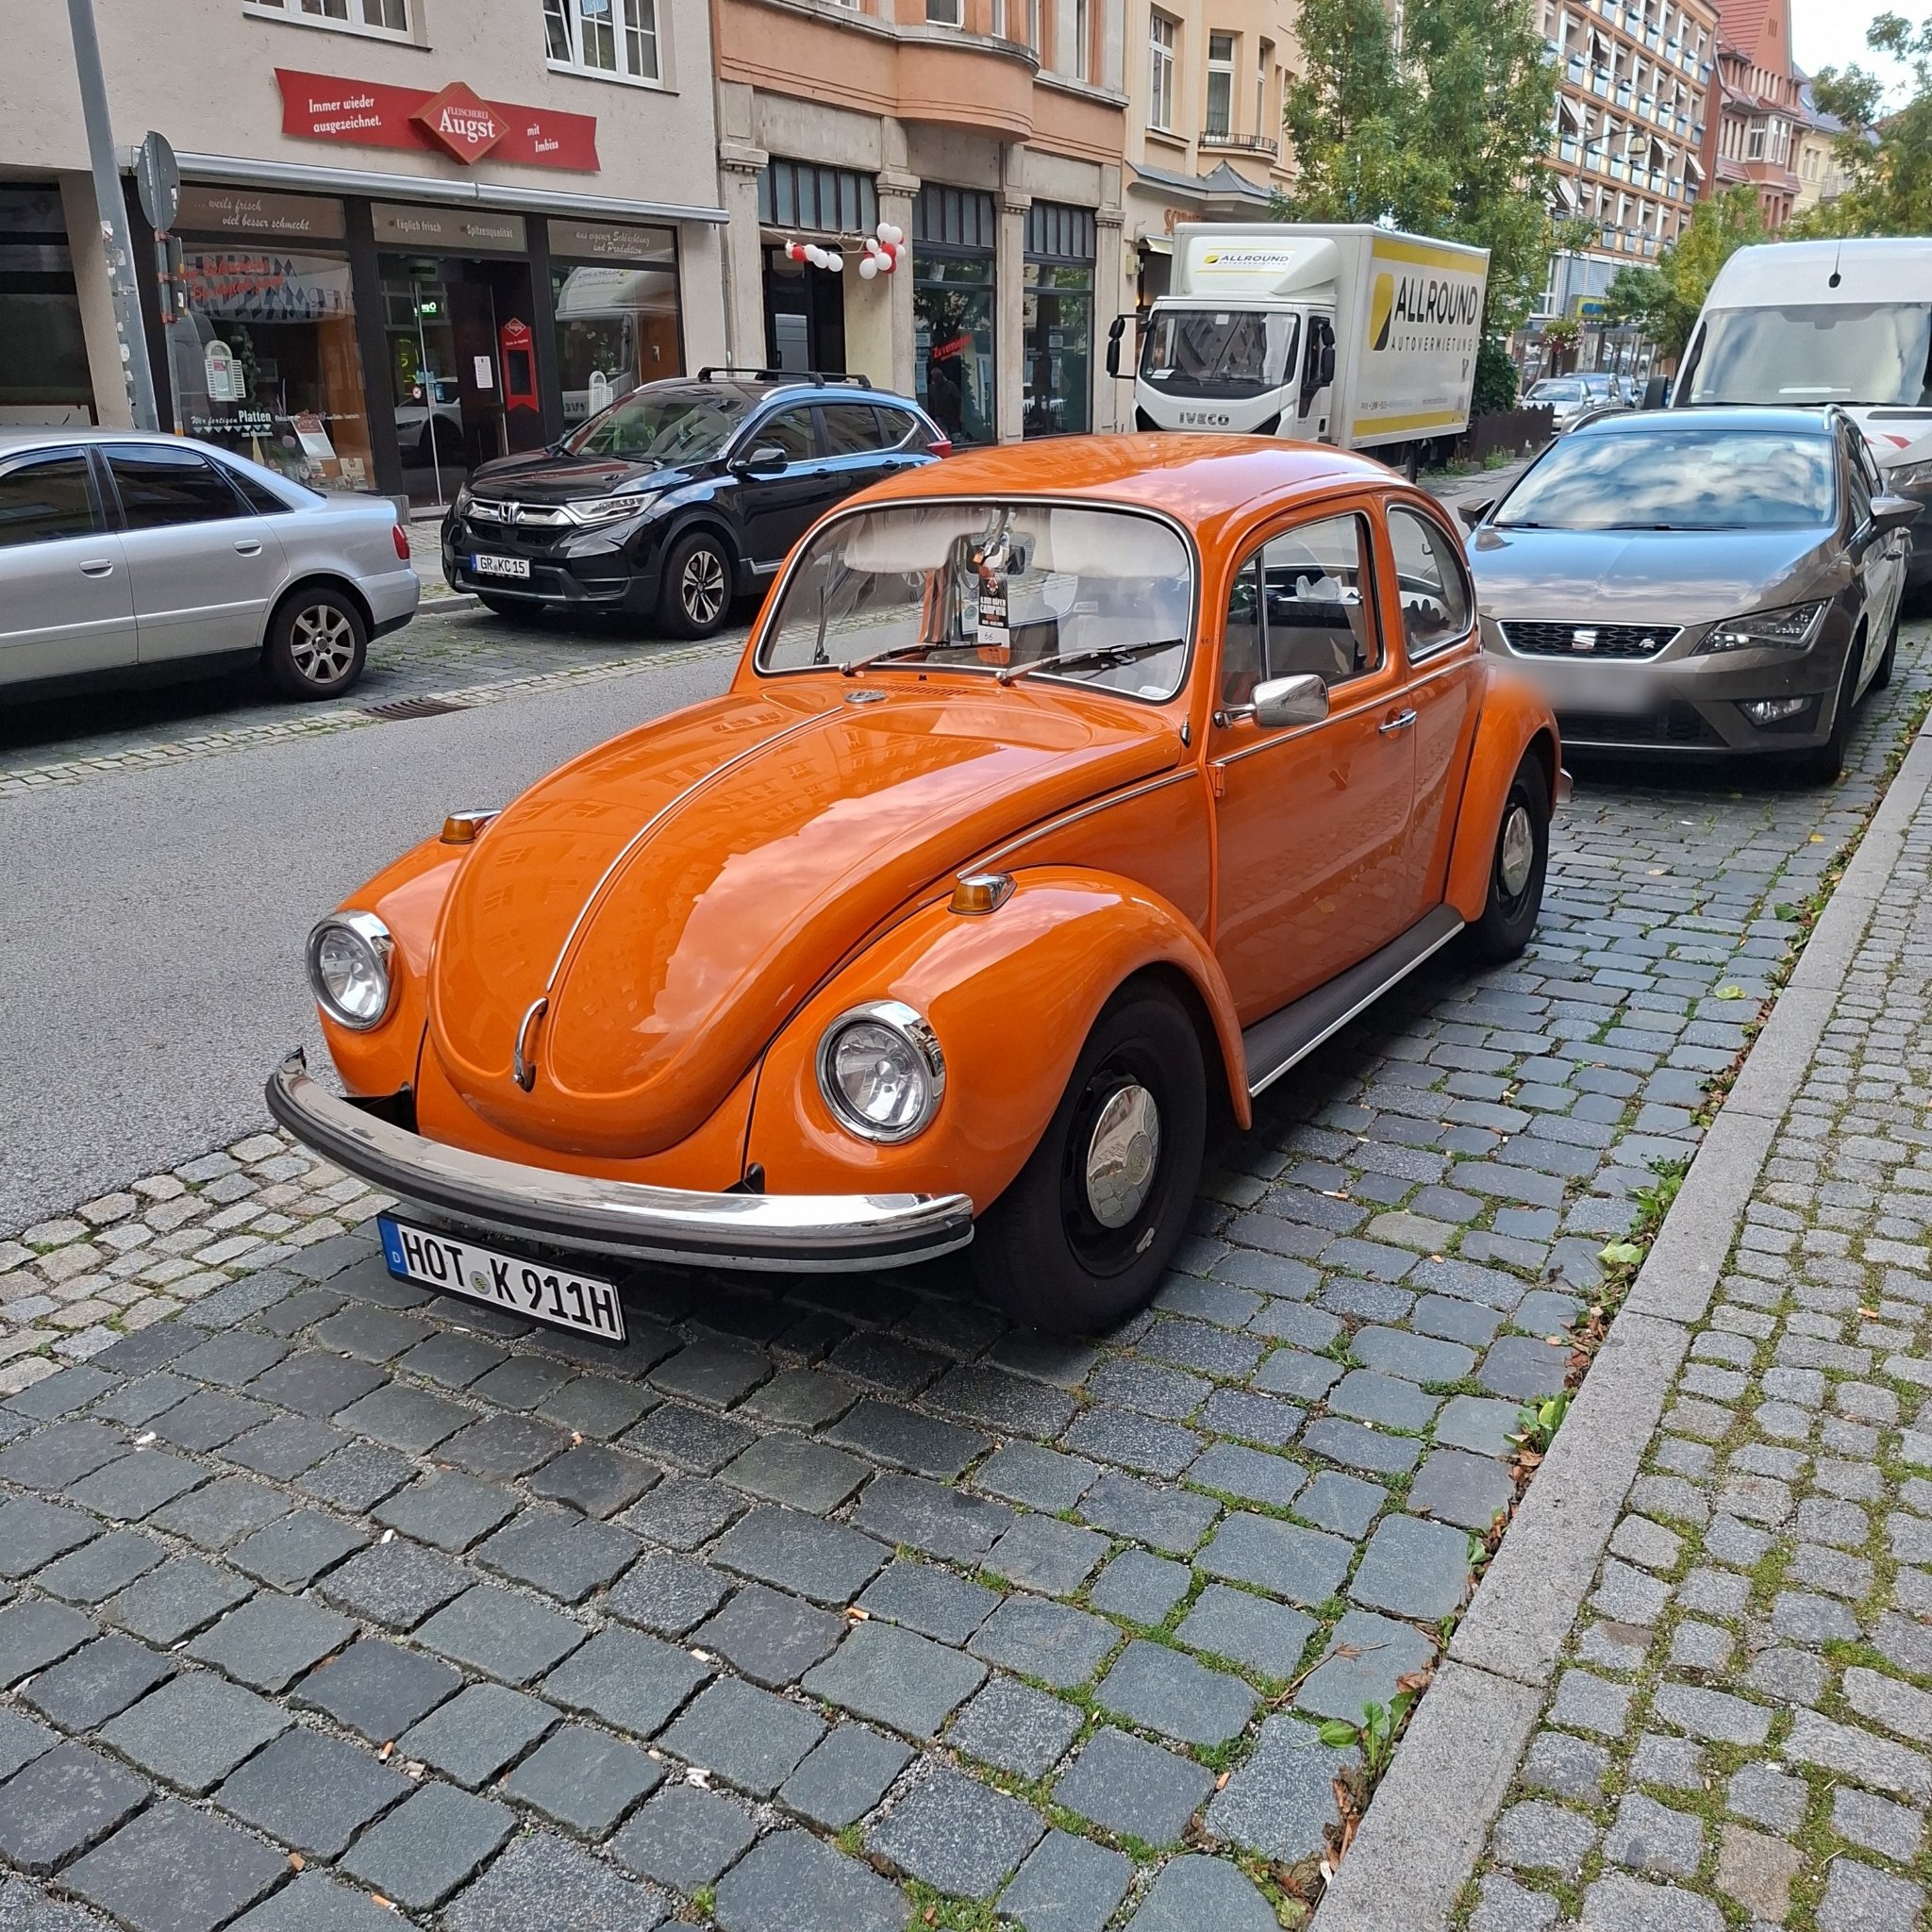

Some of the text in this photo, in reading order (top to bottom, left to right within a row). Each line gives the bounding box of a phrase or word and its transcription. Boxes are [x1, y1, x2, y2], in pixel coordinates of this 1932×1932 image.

[308, 96, 375, 113] Immer wieder
[447, 106, 489, 120] FLEISCHEREI
[313, 114, 381, 134] ausgezeichnet.
[439, 108, 496, 142] Augst
[526, 125, 540, 137] mit
[535, 139, 559, 153] Imbiss
[235, 199, 262, 214] frisch
[222, 214, 311, 230] viel besser schmeckt.
[396, 219, 441, 232] Täglich frisch
[466, 225, 513, 239] Spitzenqualität
[1394, 276, 1478, 325] ALLROUND
[1391, 336, 1473, 352] AUTOVERMIETUNG
[191, 415, 207, 425] Wir
[208, 415, 239, 426] fertigen
[238, 409, 272, 424] Platten
[1179, 411, 1229, 425] IVECO
[480, 558, 525, 574] GR KC 15
[391, 1251, 402, 1264] D
[401, 1230, 617, 1334] HOT K 911H
